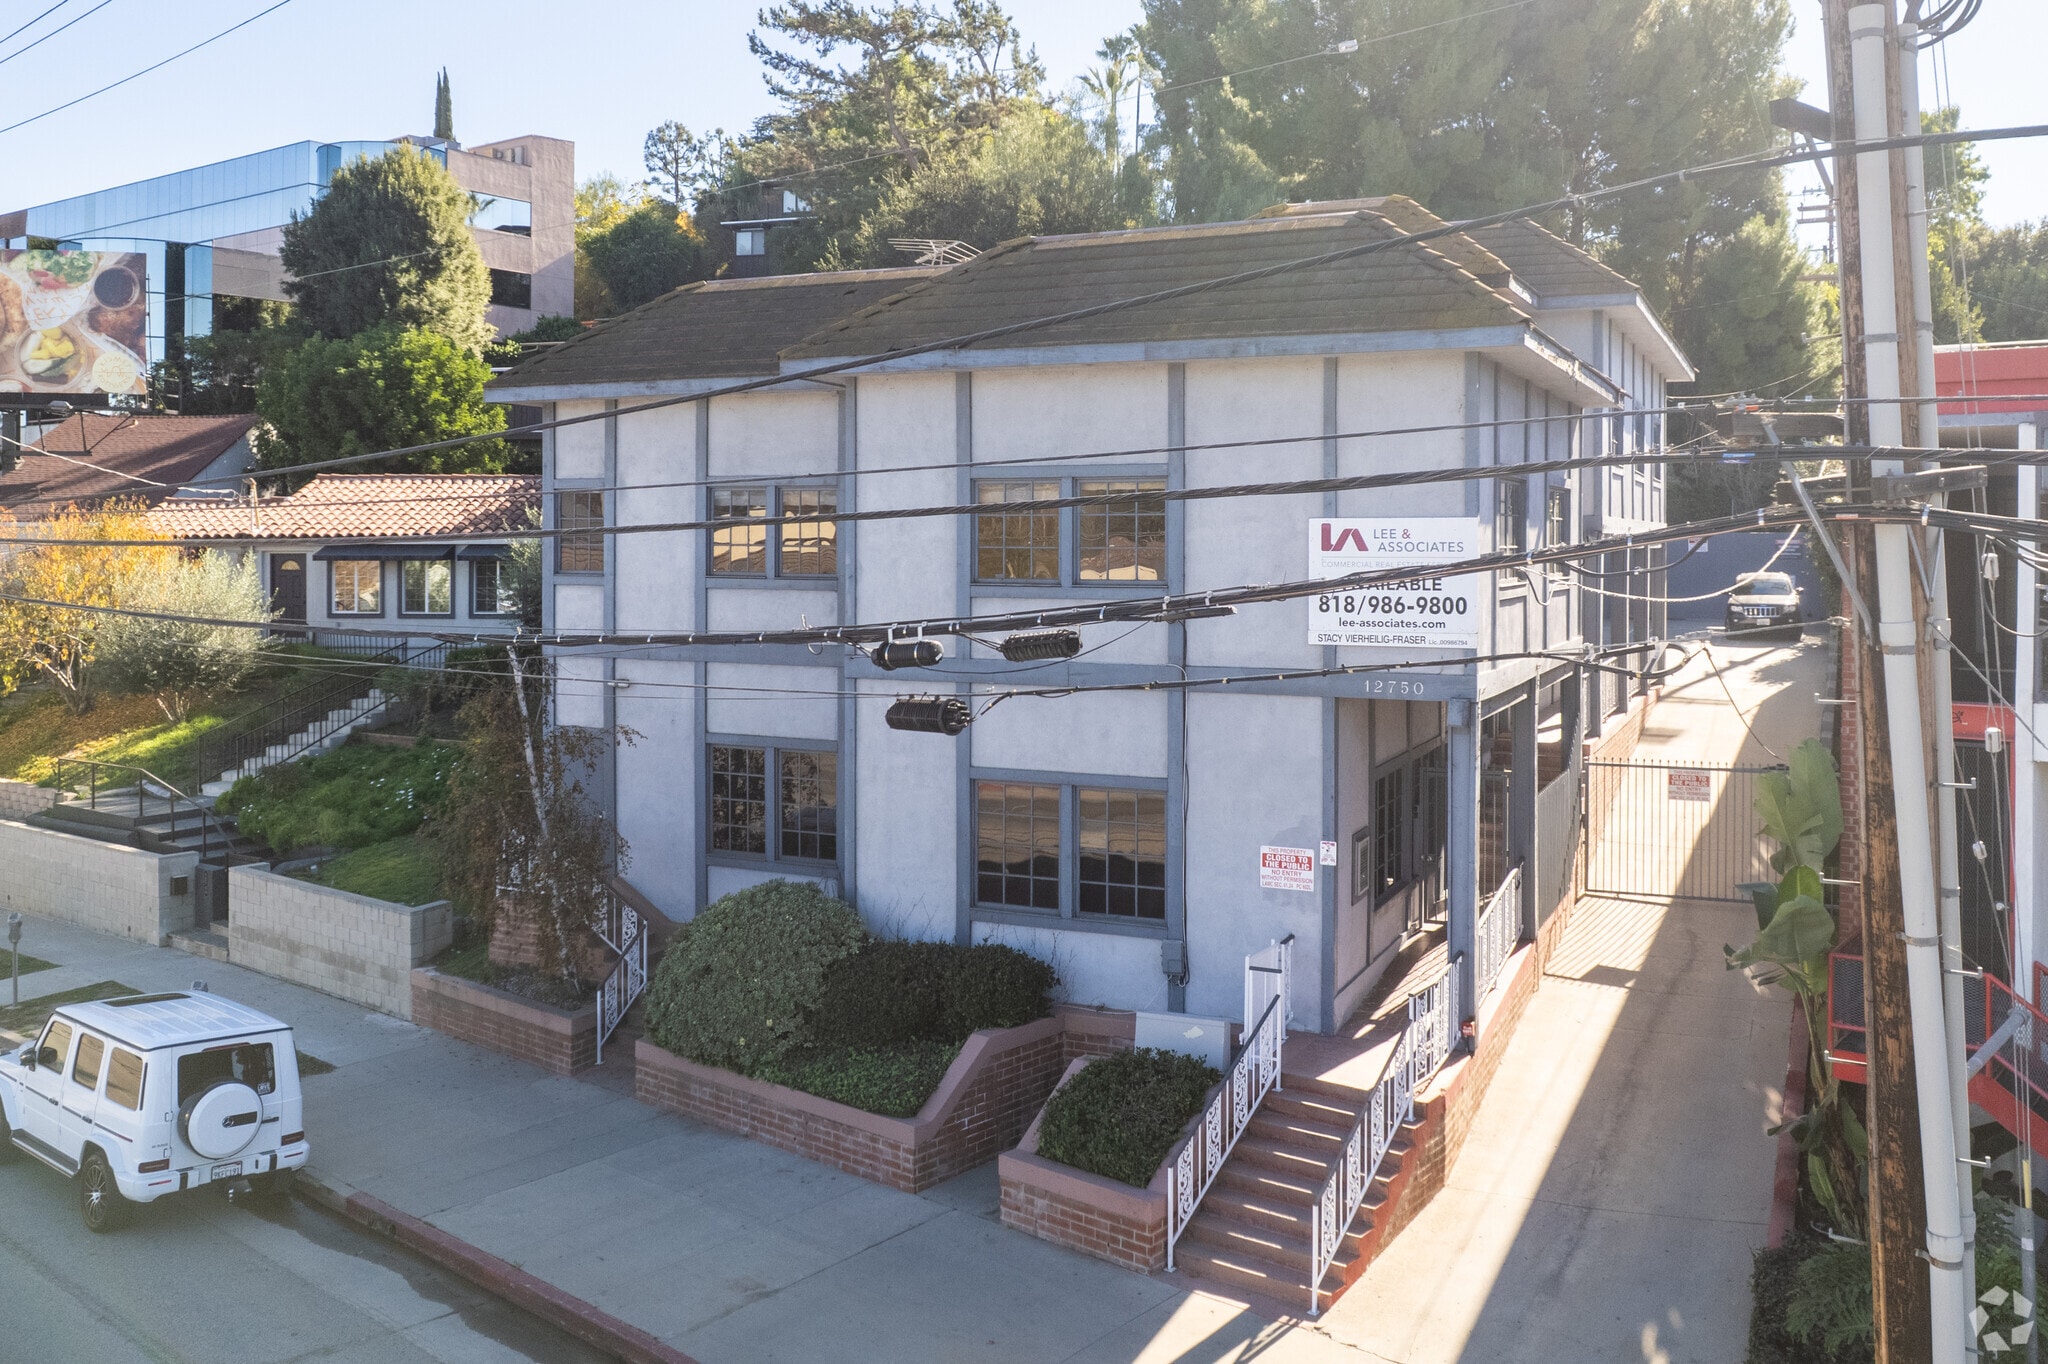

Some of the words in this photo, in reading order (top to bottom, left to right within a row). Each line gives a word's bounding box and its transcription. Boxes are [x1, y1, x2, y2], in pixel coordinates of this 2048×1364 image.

[1374, 528, 1397, 539] LEE
[1401, 528, 1411, 539] &
[1377, 541, 1464, 553] ASSOCIATES
[1318, 595, 1468, 615] 818/986-9800
[1338, 617, 1446, 629] lee-associates.com
[1317, 633, 1343, 643] STACY
[1344, 634, 1427, 645] VIERHEILIG-FRASER
[1364, 680, 1424, 695] 12750
[1266, 854, 1296, 862] CLOSED
[1282, 862, 1310, 870] PUBLIC
